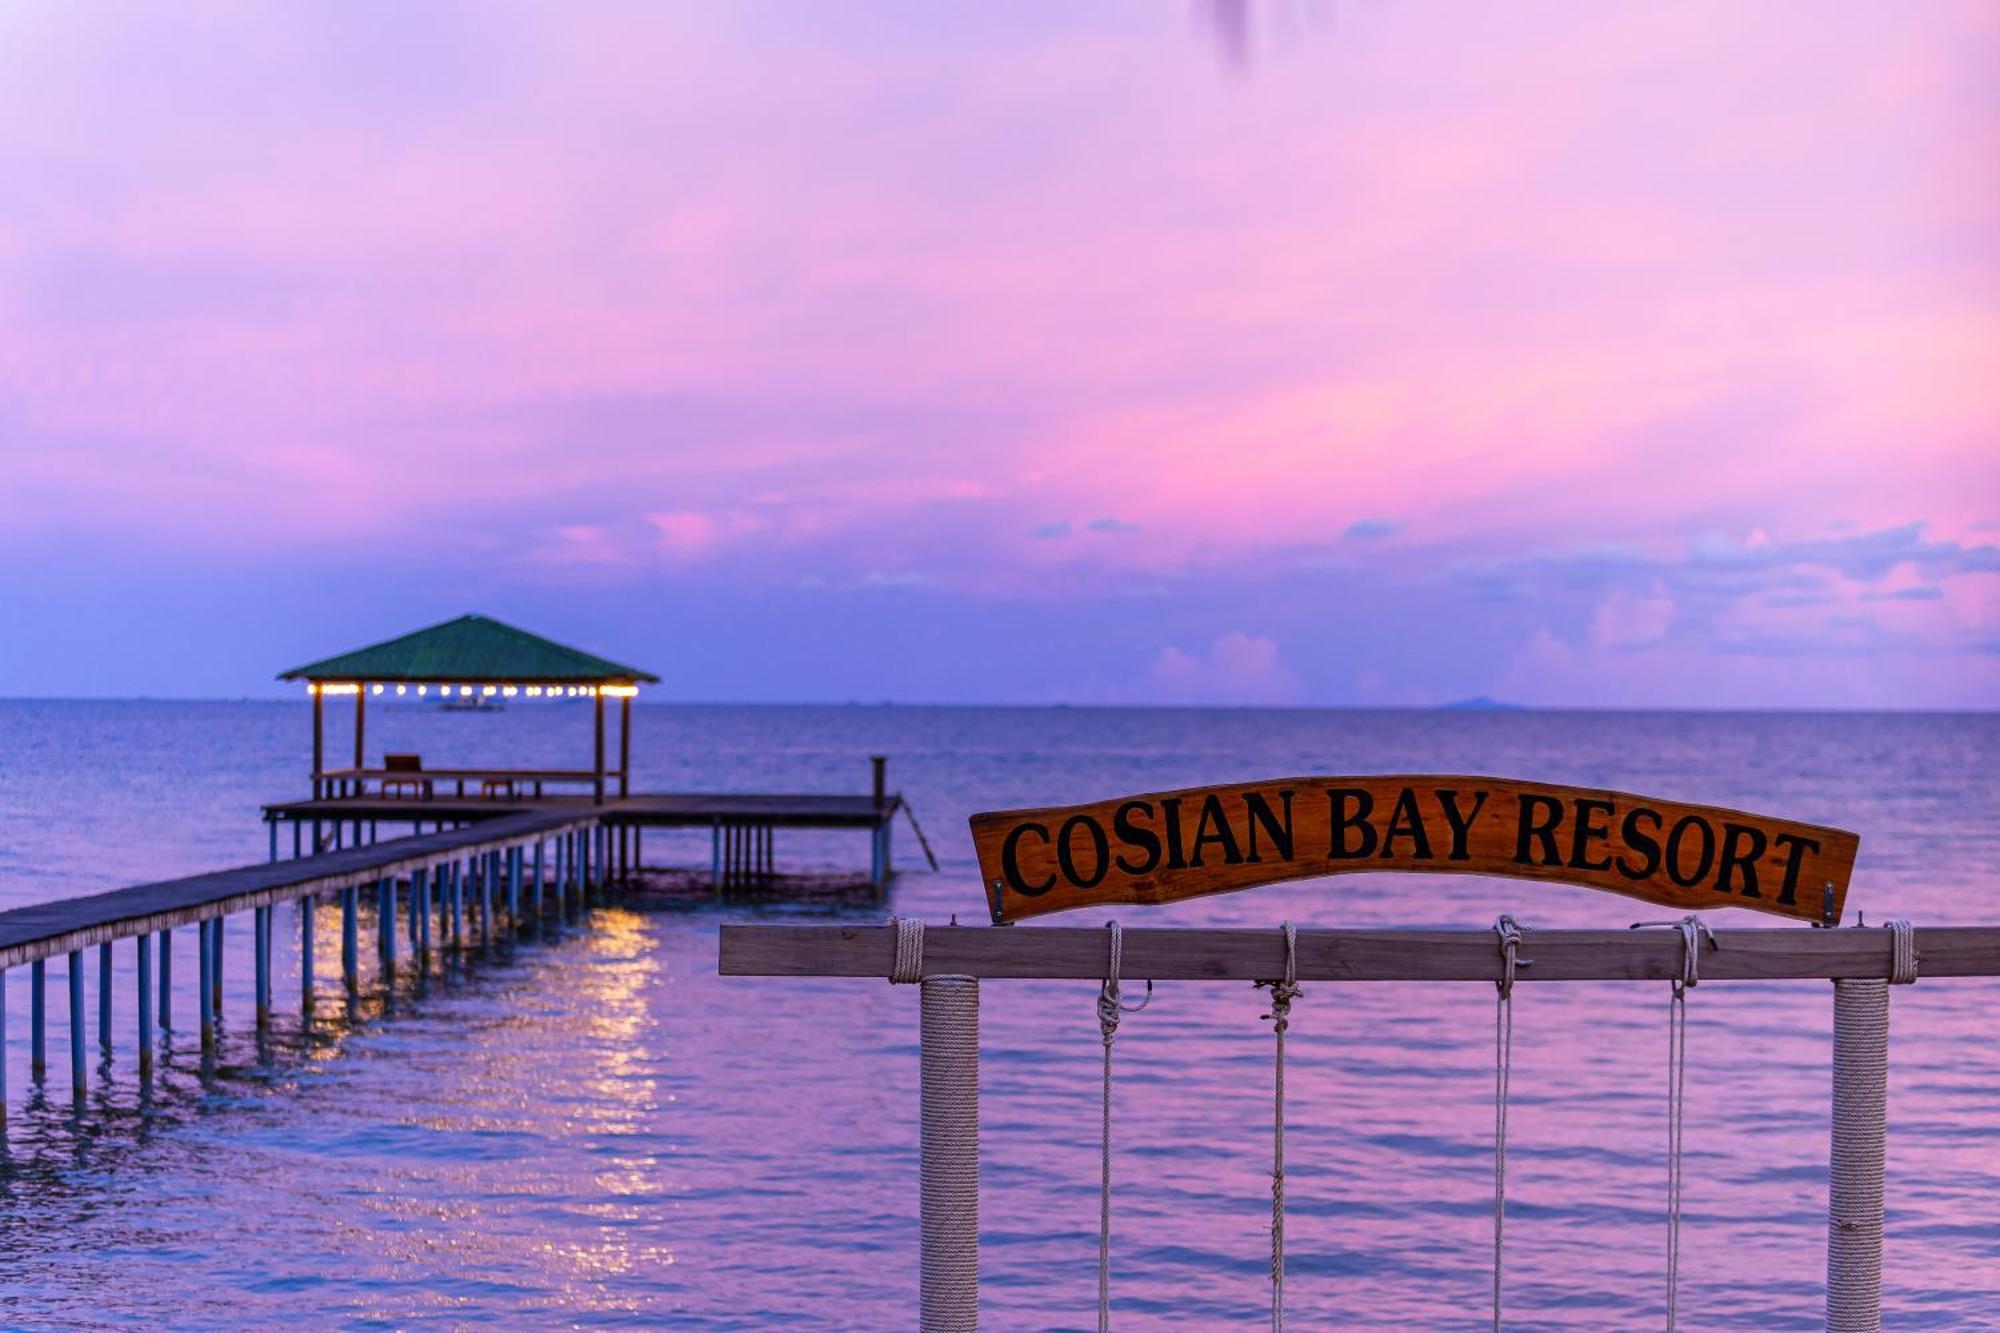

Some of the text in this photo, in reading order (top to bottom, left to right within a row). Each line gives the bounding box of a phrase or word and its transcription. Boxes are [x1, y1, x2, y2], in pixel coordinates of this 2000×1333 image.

[1002, 788, 1820, 905] COSIAN BAY RESORT
